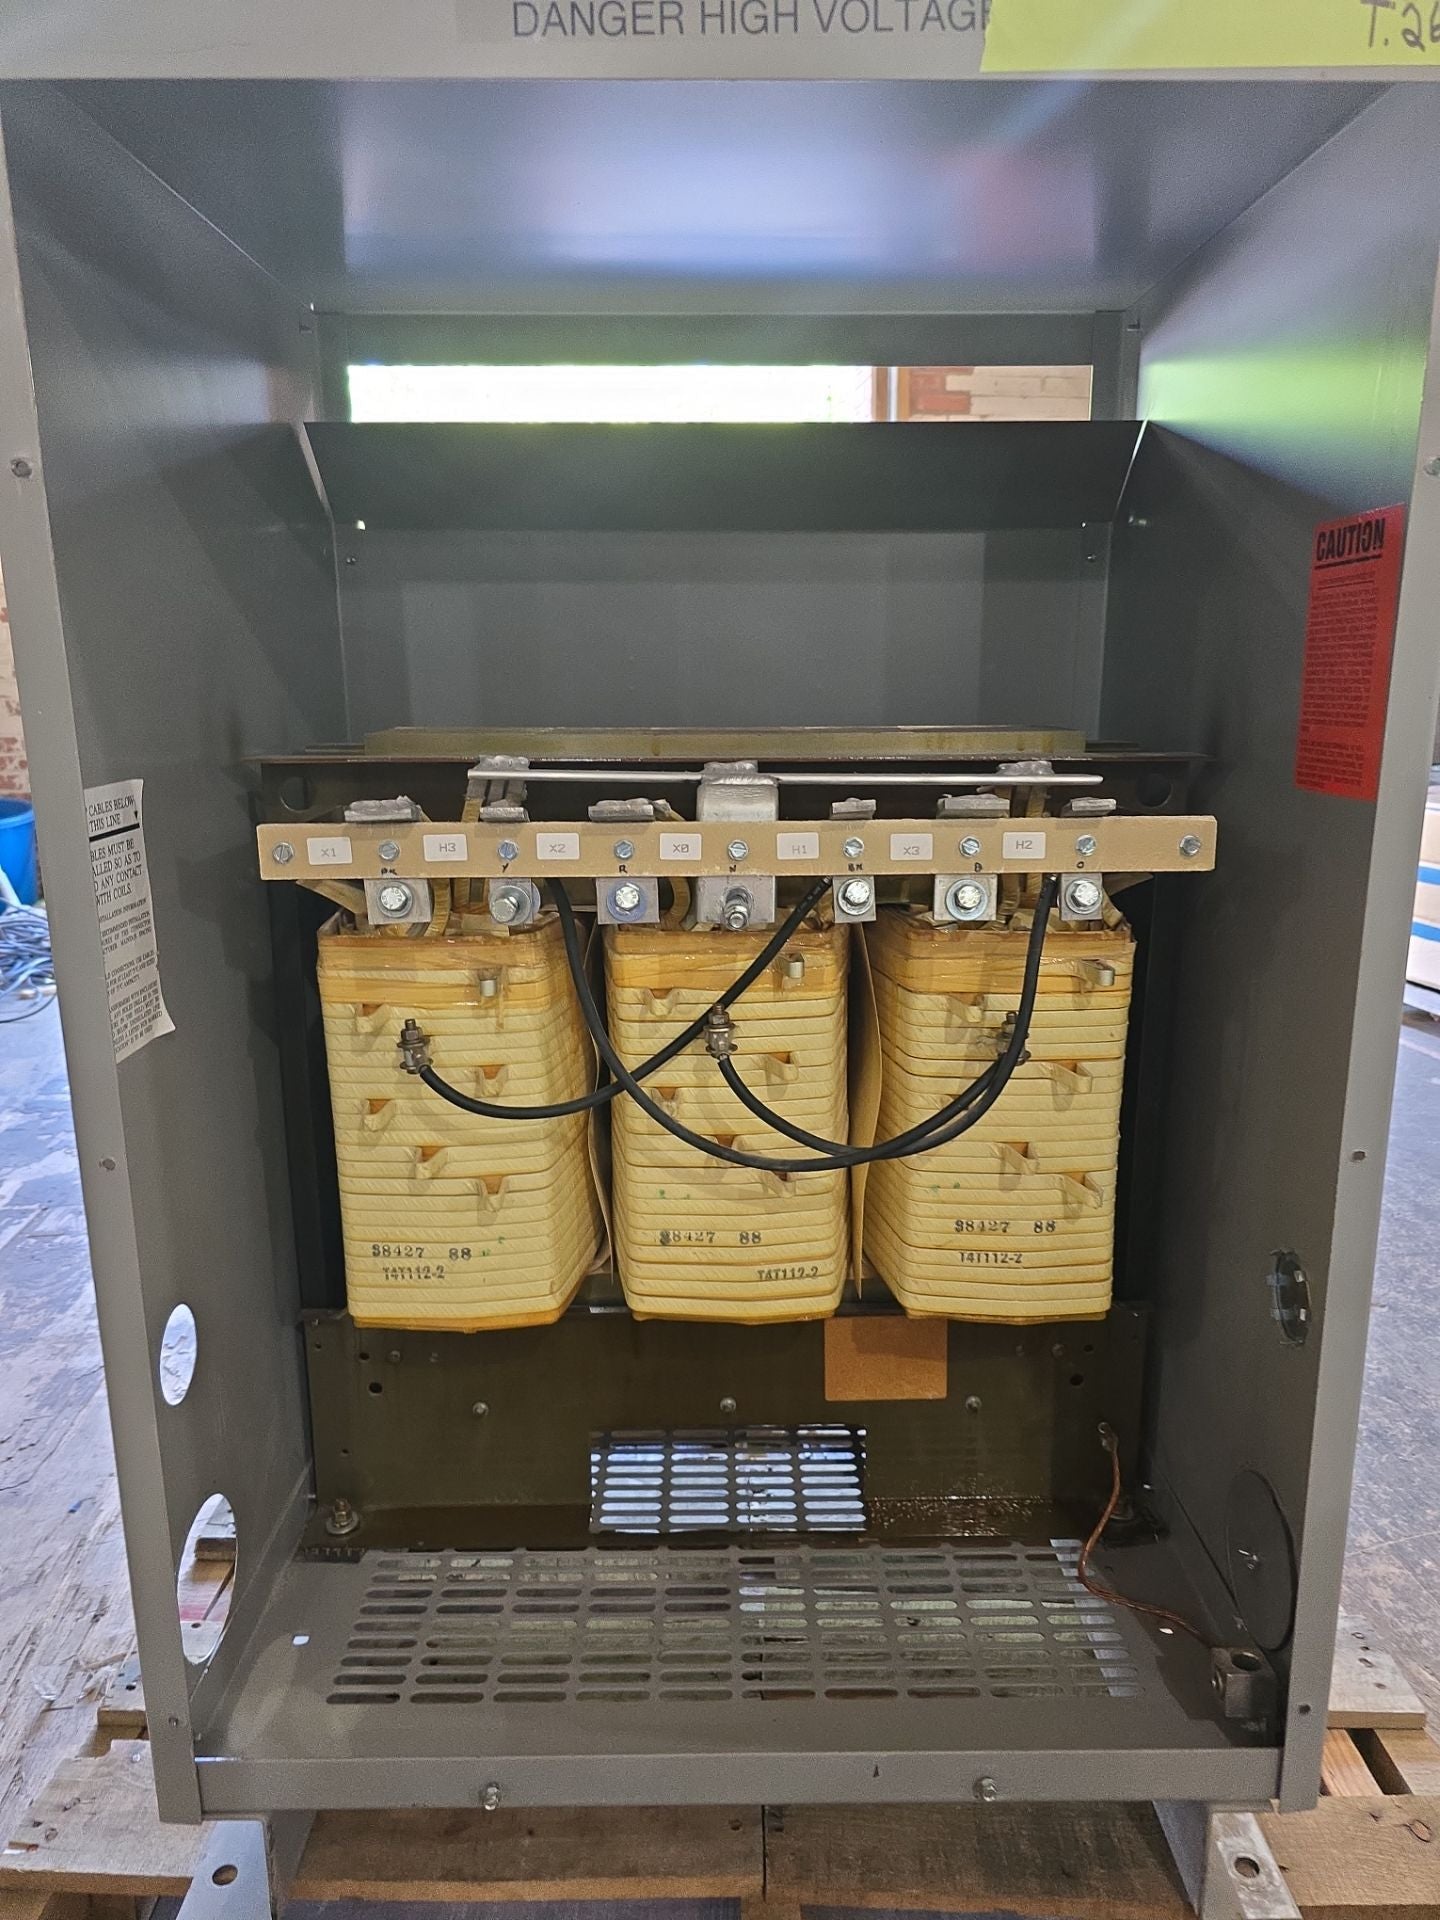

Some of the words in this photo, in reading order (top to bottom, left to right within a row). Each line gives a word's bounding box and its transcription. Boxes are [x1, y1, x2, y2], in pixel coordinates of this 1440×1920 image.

[512, 0, 684, 37] DANGER
[700, 0, 799, 35] HIGH
[1316, 518, 1386, 561] CAUTION
[89, 799, 113, 817] CABLES
[113, 795, 135, 811] BELOW
[89, 817, 105, 832] THIS
[106, 813, 121, 828] LINE
[90, 847, 106, 862] BLES
[107, 841, 125, 856] MUST
[126, 838, 135, 851] BE
[439, 842, 457, 853] H3
[549, 843, 566, 853] X2
[791, 845, 808, 855] H1
[903, 846, 920, 856] X3
[1015, 839, 1033, 850] H2
[321, 847, 338, 858] X1
[114, 857, 123, 870] SO
[124, 853, 132, 867] AS
[132, 850, 141, 863] TO
[619, 864, 628, 874] R
[729, 864, 738, 873] N
[101, 873, 114, 890] ANY
[116, 864, 142, 883] CONTACT
[1034, 1219, 1056, 1233] 88
[739, 1231, 762, 1245] 88
[449, 1247, 472, 1261] 88
